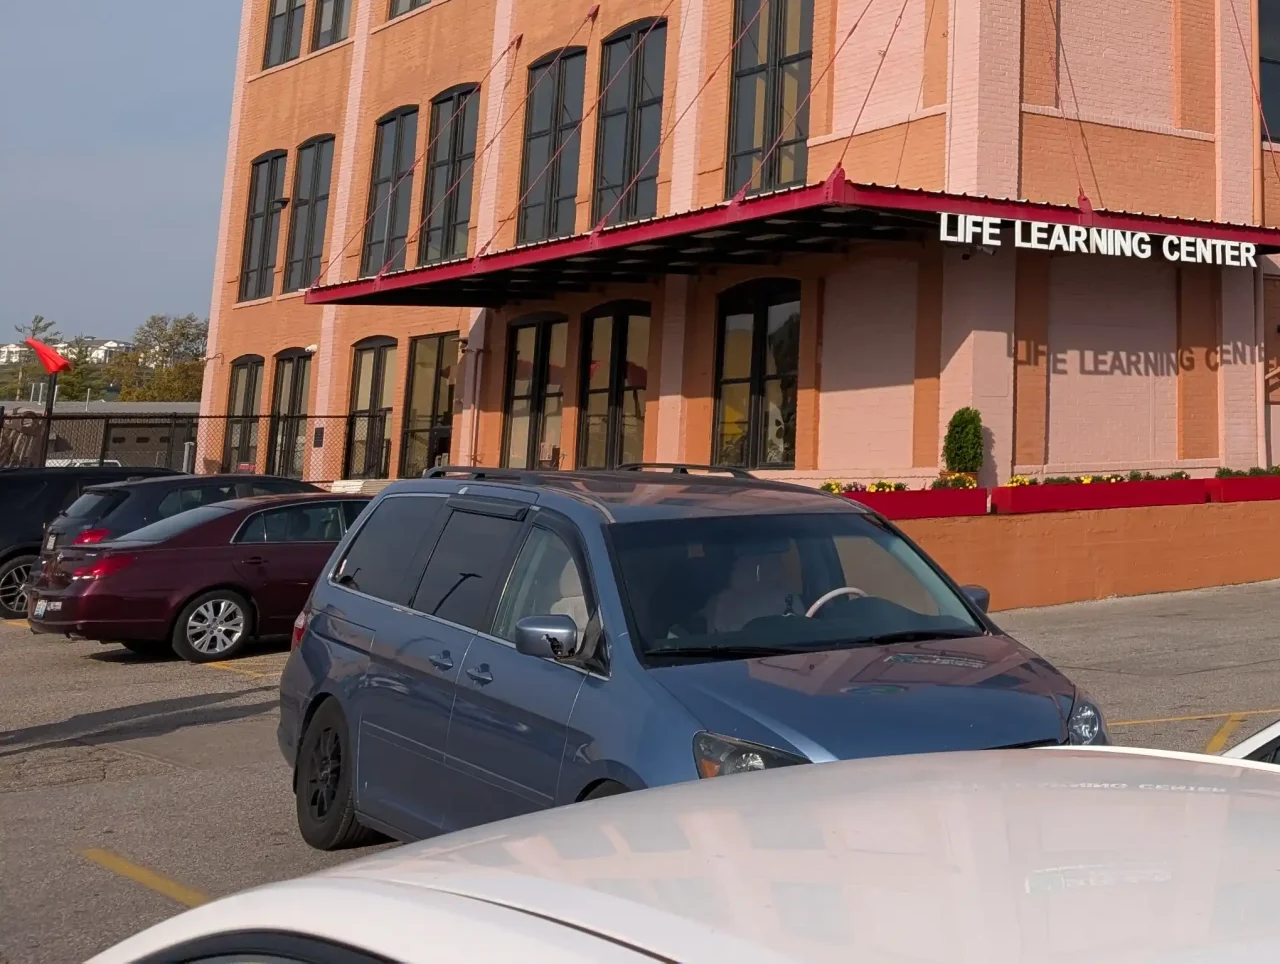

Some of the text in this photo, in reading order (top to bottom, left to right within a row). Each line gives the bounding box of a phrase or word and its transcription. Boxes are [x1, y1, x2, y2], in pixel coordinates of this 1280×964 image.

[939, 212, 1258, 268] LIFE LEARNING CENTER
